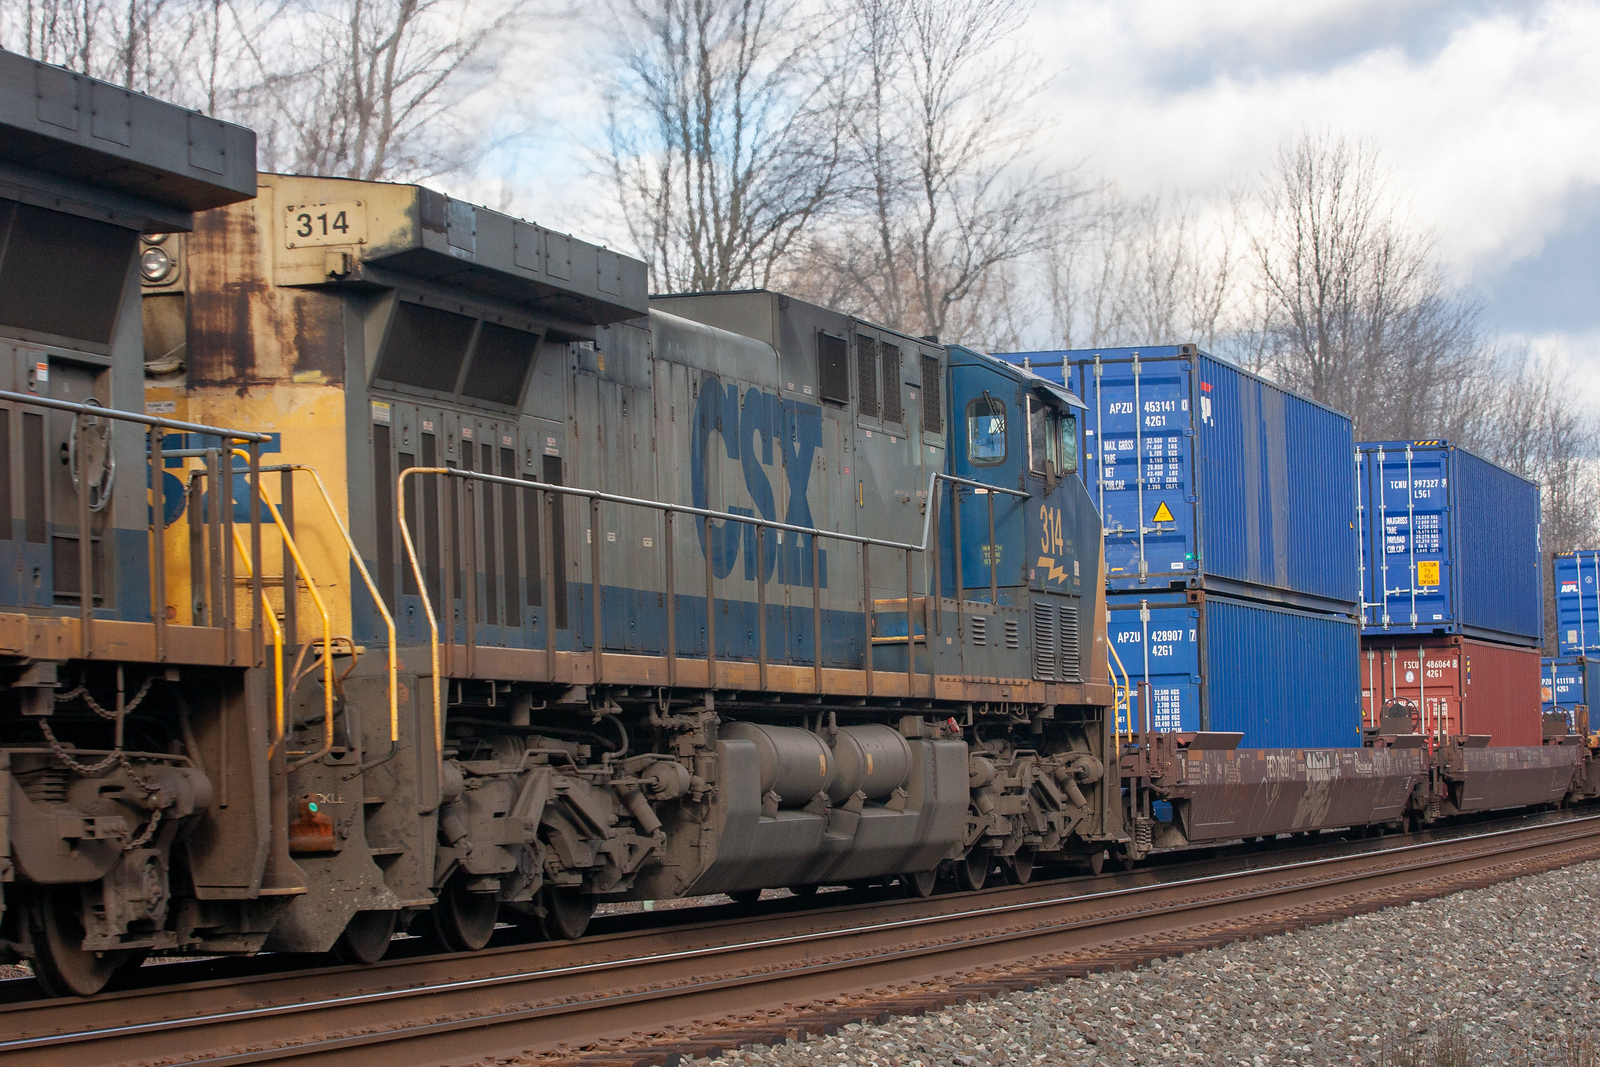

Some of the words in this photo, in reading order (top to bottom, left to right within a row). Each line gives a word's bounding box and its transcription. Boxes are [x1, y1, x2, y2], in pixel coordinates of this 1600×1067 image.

[297, 211, 349, 238] 314
[1109, 402, 1133, 414] APZU
[1144, 400, 1175, 413] 453141
[1145, 415, 1166, 427] 42G1
[1118, 439, 1134, 451] GROSS
[1105, 467, 1115, 478] NET
[691, 377, 828, 589] CSX
[1390, 480, 1407, 490] TCNU
[1414, 479, 1439, 489] 997327
[1414, 489, 1431, 499] L5G1
[1040, 504, 1064, 556] 314
[1561, 584, 1579, 593] APL
[1117, 631, 1141, 644] APZU
[1151, 629, 1183, 642] 428907
[1189, 629, 1196, 642] 7
[1152, 644, 1173, 657] 42G1
[1403, 661, 1419, 669] FSCU
[1426, 660, 1451, 668] 486064
[1426, 669, 1442, 678] 42G1
